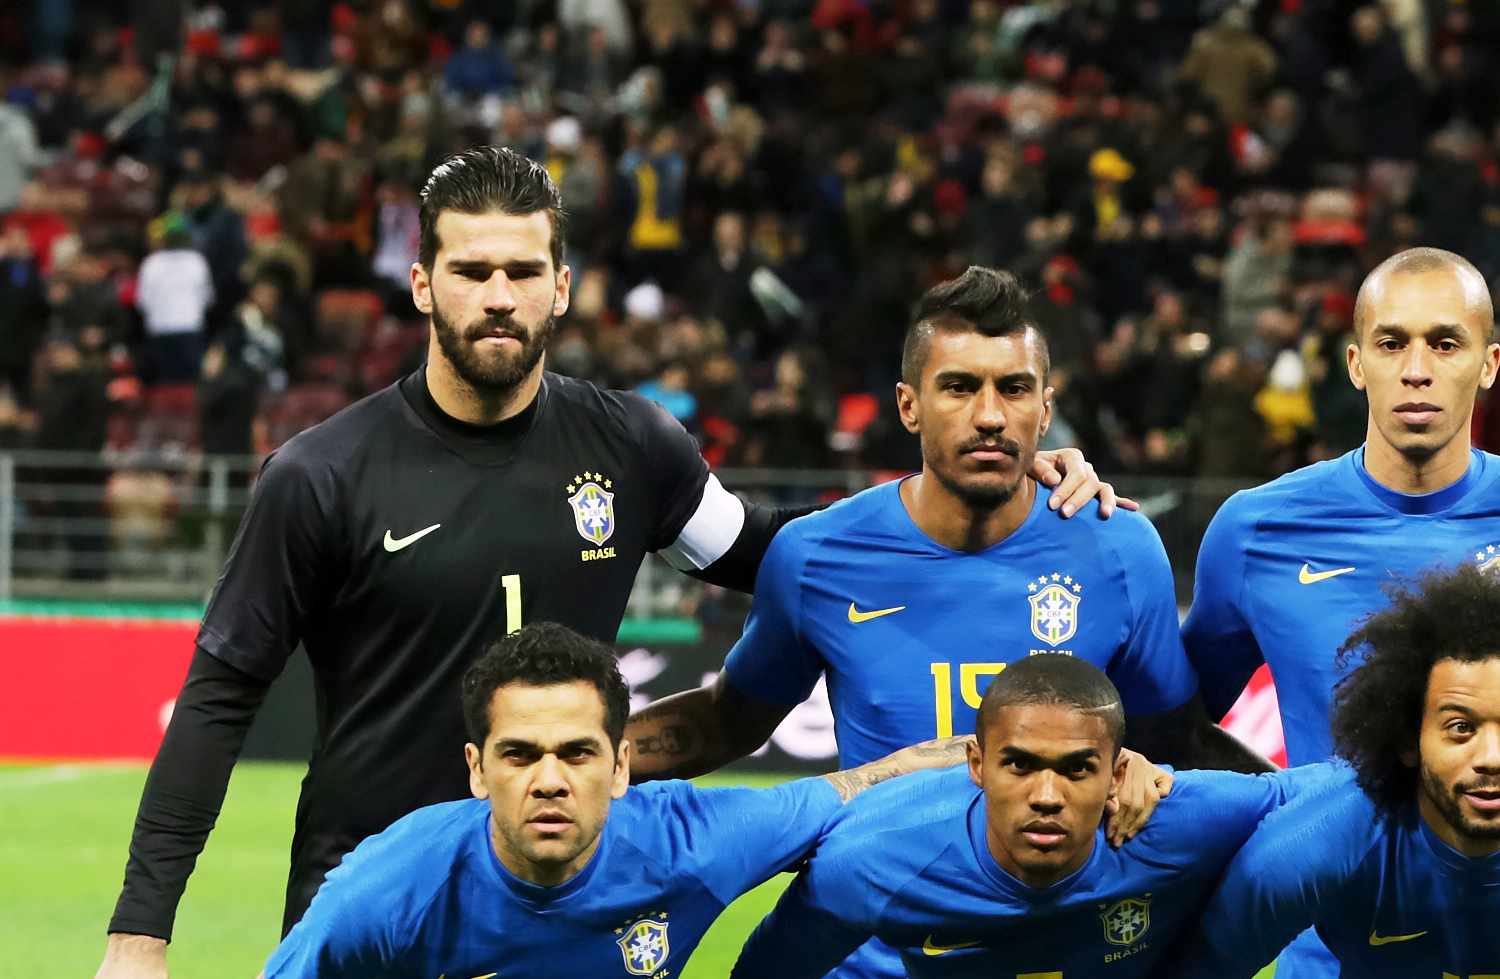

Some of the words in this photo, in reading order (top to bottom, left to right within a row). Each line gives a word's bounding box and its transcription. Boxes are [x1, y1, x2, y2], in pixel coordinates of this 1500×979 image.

[581, 547, 617, 561] BRASIL
[501, 574, 522, 637] 1
[1046, 610, 1062, 618] CBF
[1119, 916, 1135, 926] CBF
[638, 943, 654, 953] CBF
[1104, 942, 1149, 963] BRASIL
